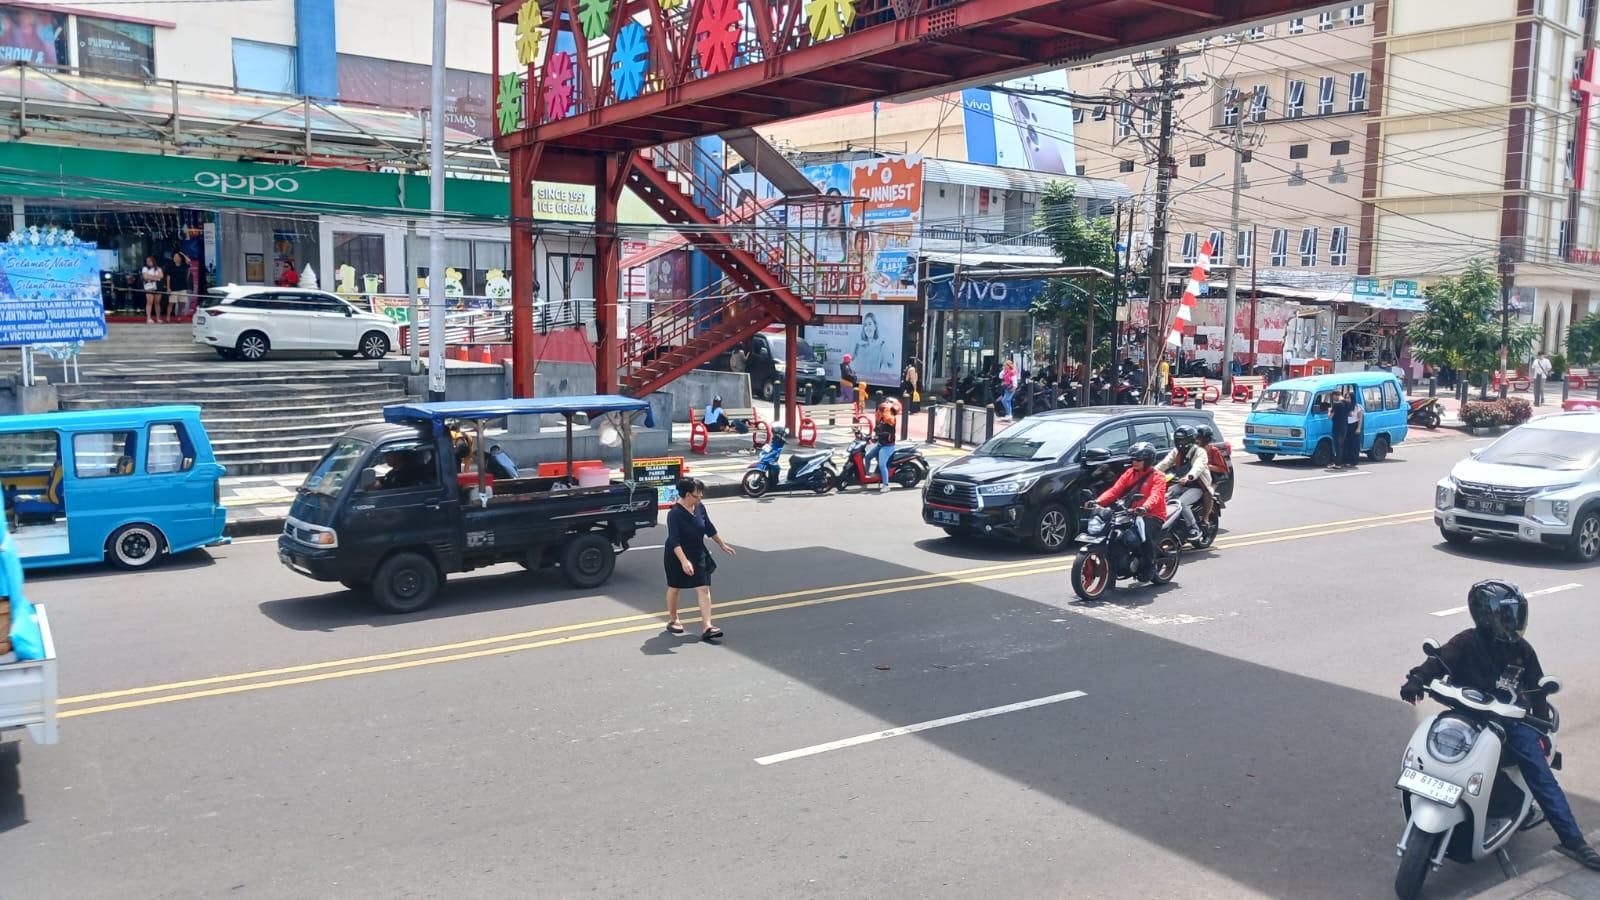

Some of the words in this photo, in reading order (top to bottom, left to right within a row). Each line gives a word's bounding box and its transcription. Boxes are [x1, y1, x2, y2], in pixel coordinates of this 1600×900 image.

[538, 188, 567, 201] SINCE
[859, 183, 915, 203] SUNNIEST
[538, 202, 553, 213] ICE
[556, 203, 588, 216] CREAM
[7, 257, 49, 268] Selamat
[49, 257, 80, 270] Natal
[882, 262, 902, 274] BABY
[10, 332, 36, 340] VICTOR
[1404, 769, 1417, 780] DB
[1421, 776, 1445, 790] 6179
[1446, 785, 1459, 794] RY
